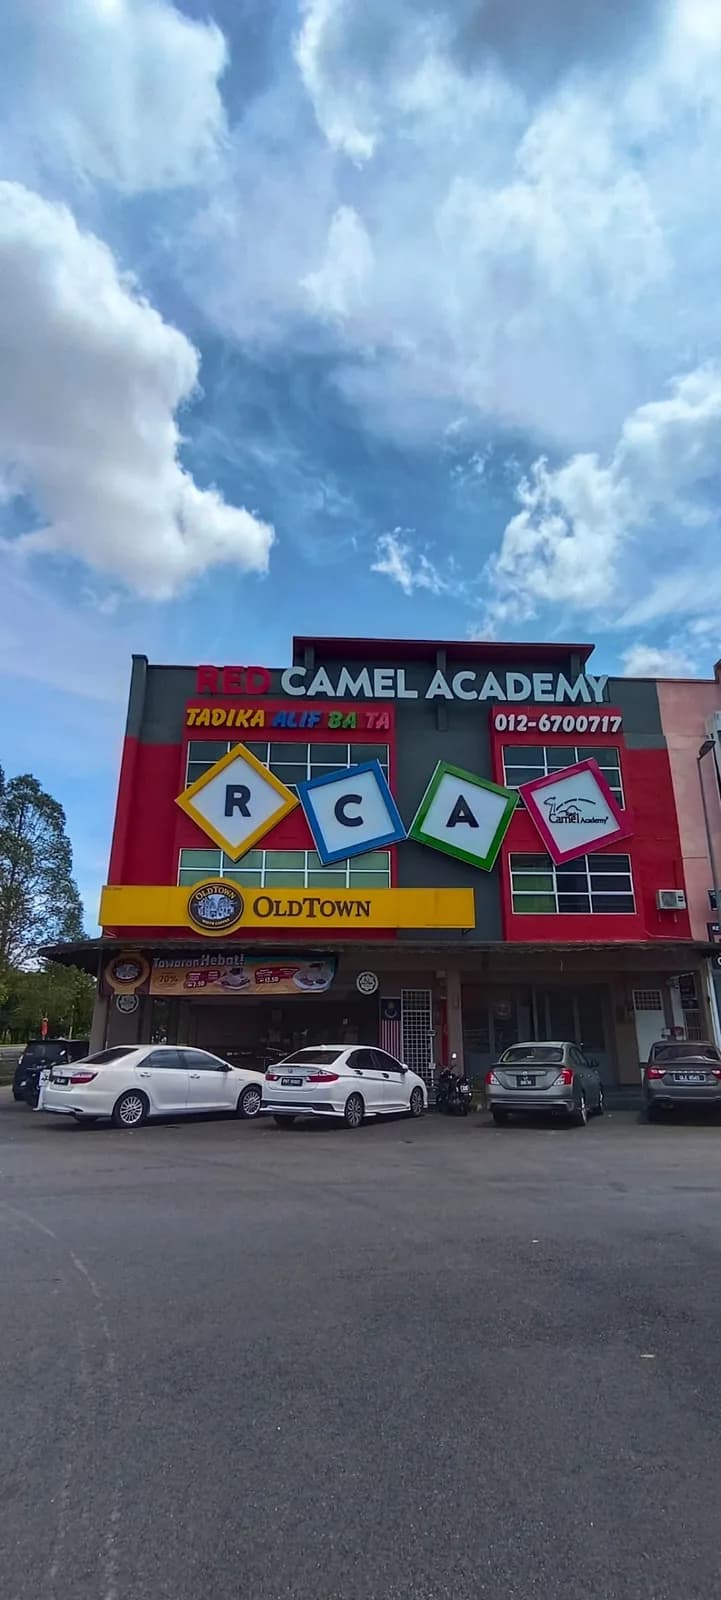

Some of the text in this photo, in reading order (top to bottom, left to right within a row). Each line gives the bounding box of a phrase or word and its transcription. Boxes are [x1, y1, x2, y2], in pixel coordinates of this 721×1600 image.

[196, 666, 608, 702] RED CAMEL ACADEMY
[186, 708, 390, 729] TADIKA ALIF BA TA
[495, 714, 622, 732] 012-6700717
[224, 784, 251, 817] R
[334, 794, 364, 827] C
[446, 794, 480, 828] A
[549, 813, 608, 824] Camel Academy
[195, 886, 237, 900] OLDTOWN
[153, 957, 200, 968] Tawaran
